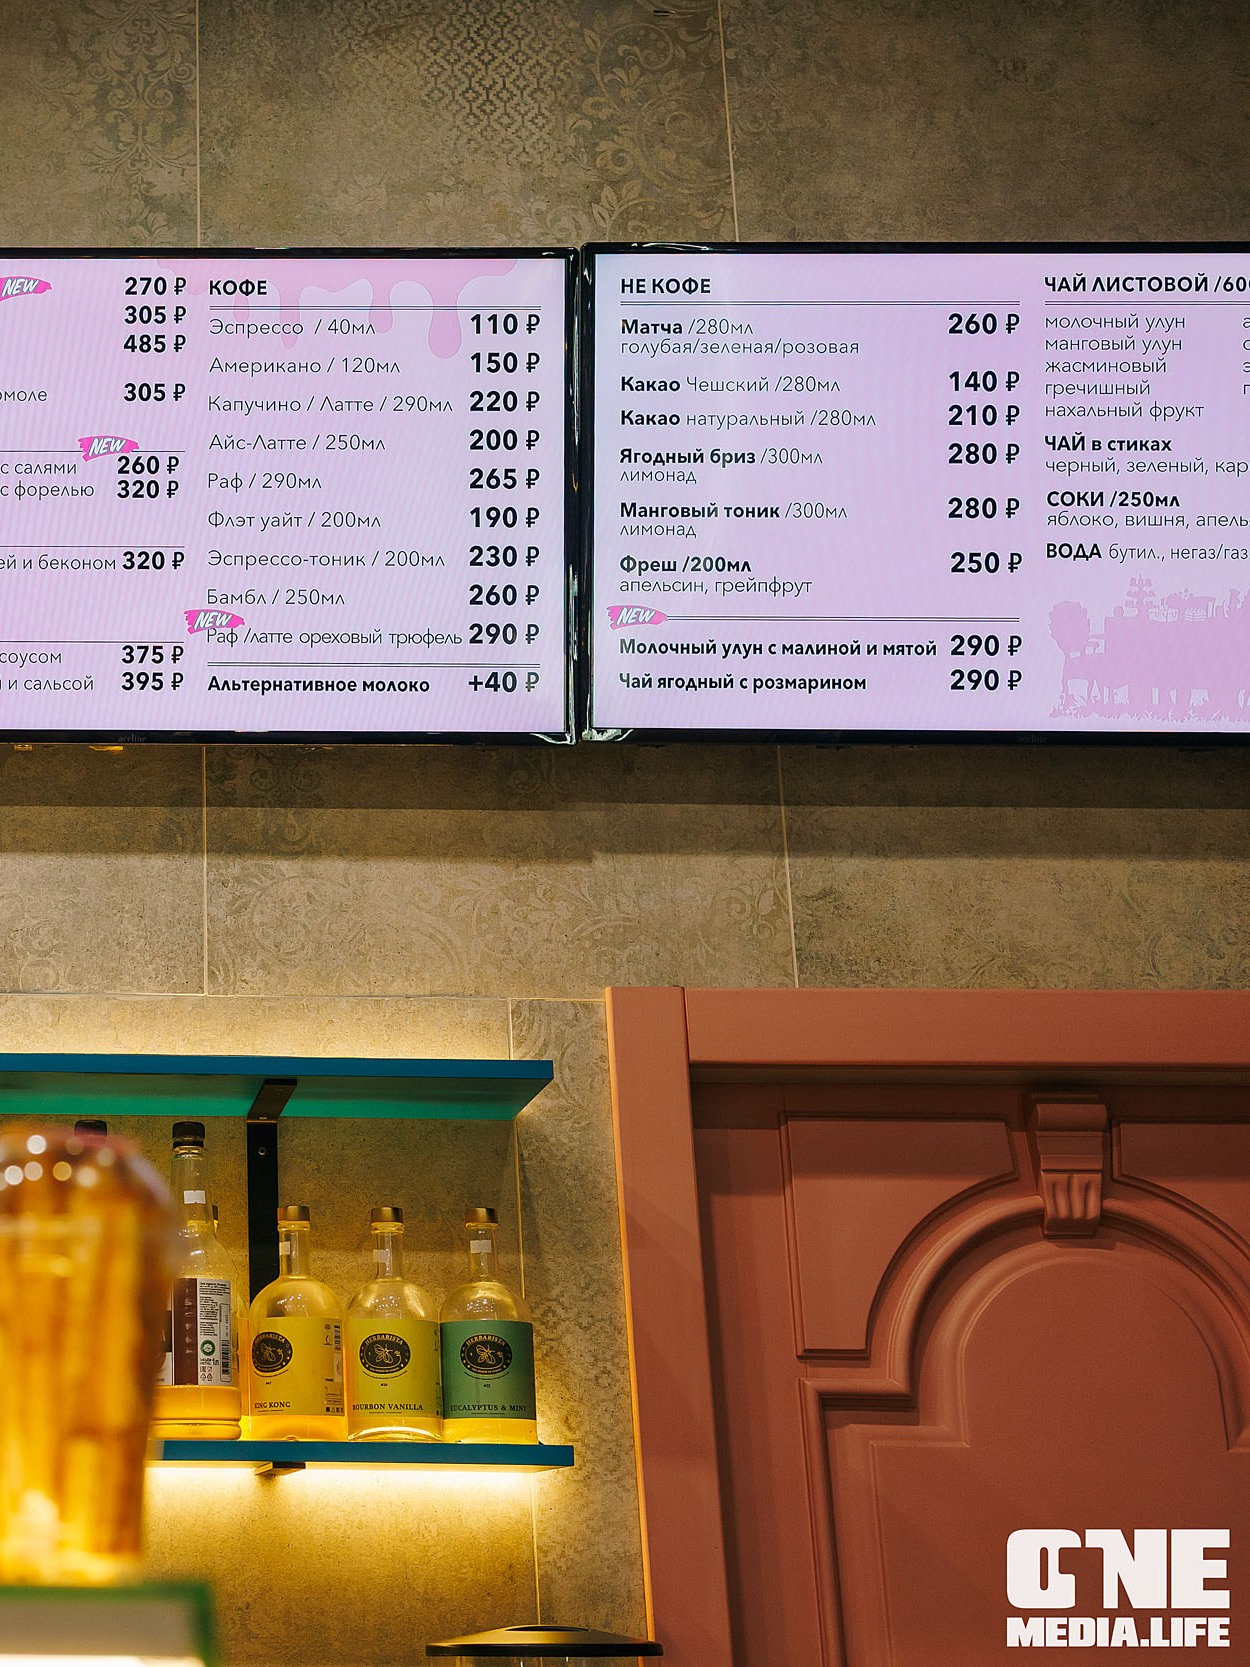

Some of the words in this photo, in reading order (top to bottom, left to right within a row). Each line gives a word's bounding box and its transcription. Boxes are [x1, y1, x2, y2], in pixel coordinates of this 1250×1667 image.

[0, 277, 39, 297] NEW
[125, 277, 166, 295] 270
[210, 279, 267, 296] КОФЕ
[622, 279, 646, 293] НЕ
[653, 277, 710, 295] КОФЕ
[1045, 273, 1086, 292] ЧАЙ
[1092, 273, 1207, 292] ЛИСТОВОЙ
[1214, 276, 1250, 292] /60
[471, 314, 518, 334] 110
[622, 319, 682, 334] Матча
[688, 319, 753, 334] /280мл
[949, 313, 997, 334] 260
[1046, 313, 1138, 328] молочный
[1146, 318, 1184, 333] улун
[124, 335, 165, 353] 485
[622, 338, 858, 358] голубая/зеленая/розовая
[1046, 335, 1134, 350] манговый
[1142, 340, 1181, 355] улун
[1046, 358, 1166, 372] жасминовый
[622, 377, 680, 391] Какао
[687, 377, 768, 391] Чешский
[775, 376, 840, 392] /280мл
[1046, 380, 1149, 399] гречишный
[1046, 402, 1142, 417] нахальный
[1150, 401, 1204, 421] фрукт
[88, 437, 126, 456] NEW
[209, 435, 306, 449] Айс-Латте
[326, 435, 385, 450] 250мл
[470, 429, 517, 450] 200
[1045, 434, 1085, 451] ЧАЙ
[1092, 440, 1101, 450] в
[1108, 440, 1172, 451] стиках
[620, 449, 703, 466] Ягодный
[710, 449, 755, 468] бриз
[761, 448, 822, 464] /300мл
[1046, 457, 1119, 476] черный,
[1127, 458, 1208, 475] зеленый,
[621, 471, 696, 484] лимонад
[1047, 491, 1103, 506] СОКИ
[1110, 491, 1180, 507] /250мл
[621, 503, 718, 517] Манговый
[724, 507, 779, 517] тоник
[785, 503, 847, 518] /300мл
[1048, 511, 1117, 528] яблоко,
[1126, 516, 1189, 529] вишня,
[1197, 516, 1250, 526] апель
[209, 511, 255, 527] Флэт
[261, 513, 302, 531] уайт
[321, 512, 380, 527] 200мл
[620, 525, 696, 538] лимонад
[951, 552, 999, 573] 250
[1047, 543, 1102, 561] ВОДА
[1109, 544, 1164, 563] бутил.,
[1171, 544, 1248, 559] негаз/газ
[620, 555, 676, 576] Фреш
[682, 556, 751, 572] /200мл
[620, 581, 707, 594] апельсин,
[716, 576, 812, 597] грейпфрут
[192, 610, 232, 631] NEW
[616, 607, 655, 626] NEW
[206, 625, 238, 647] Раф
[244, 628, 292, 643] /латте
[300, 629, 381, 648] ореховый
[389, 628, 462, 648] трюфель
[208, 676, 357, 695] Альтернативное
[363, 681, 429, 692] молоко
[469, 672, 517, 692] +40
[364, 1334, 403, 1346] HERBARISTA
[465, 1335, 506, 1347] HERBARISTA
[352, 1403, 386, 1411] BOURBON
[388, 1403, 424, 1411] VANILLA
[450, 1404, 499, 1412] EUCALYPTUS
